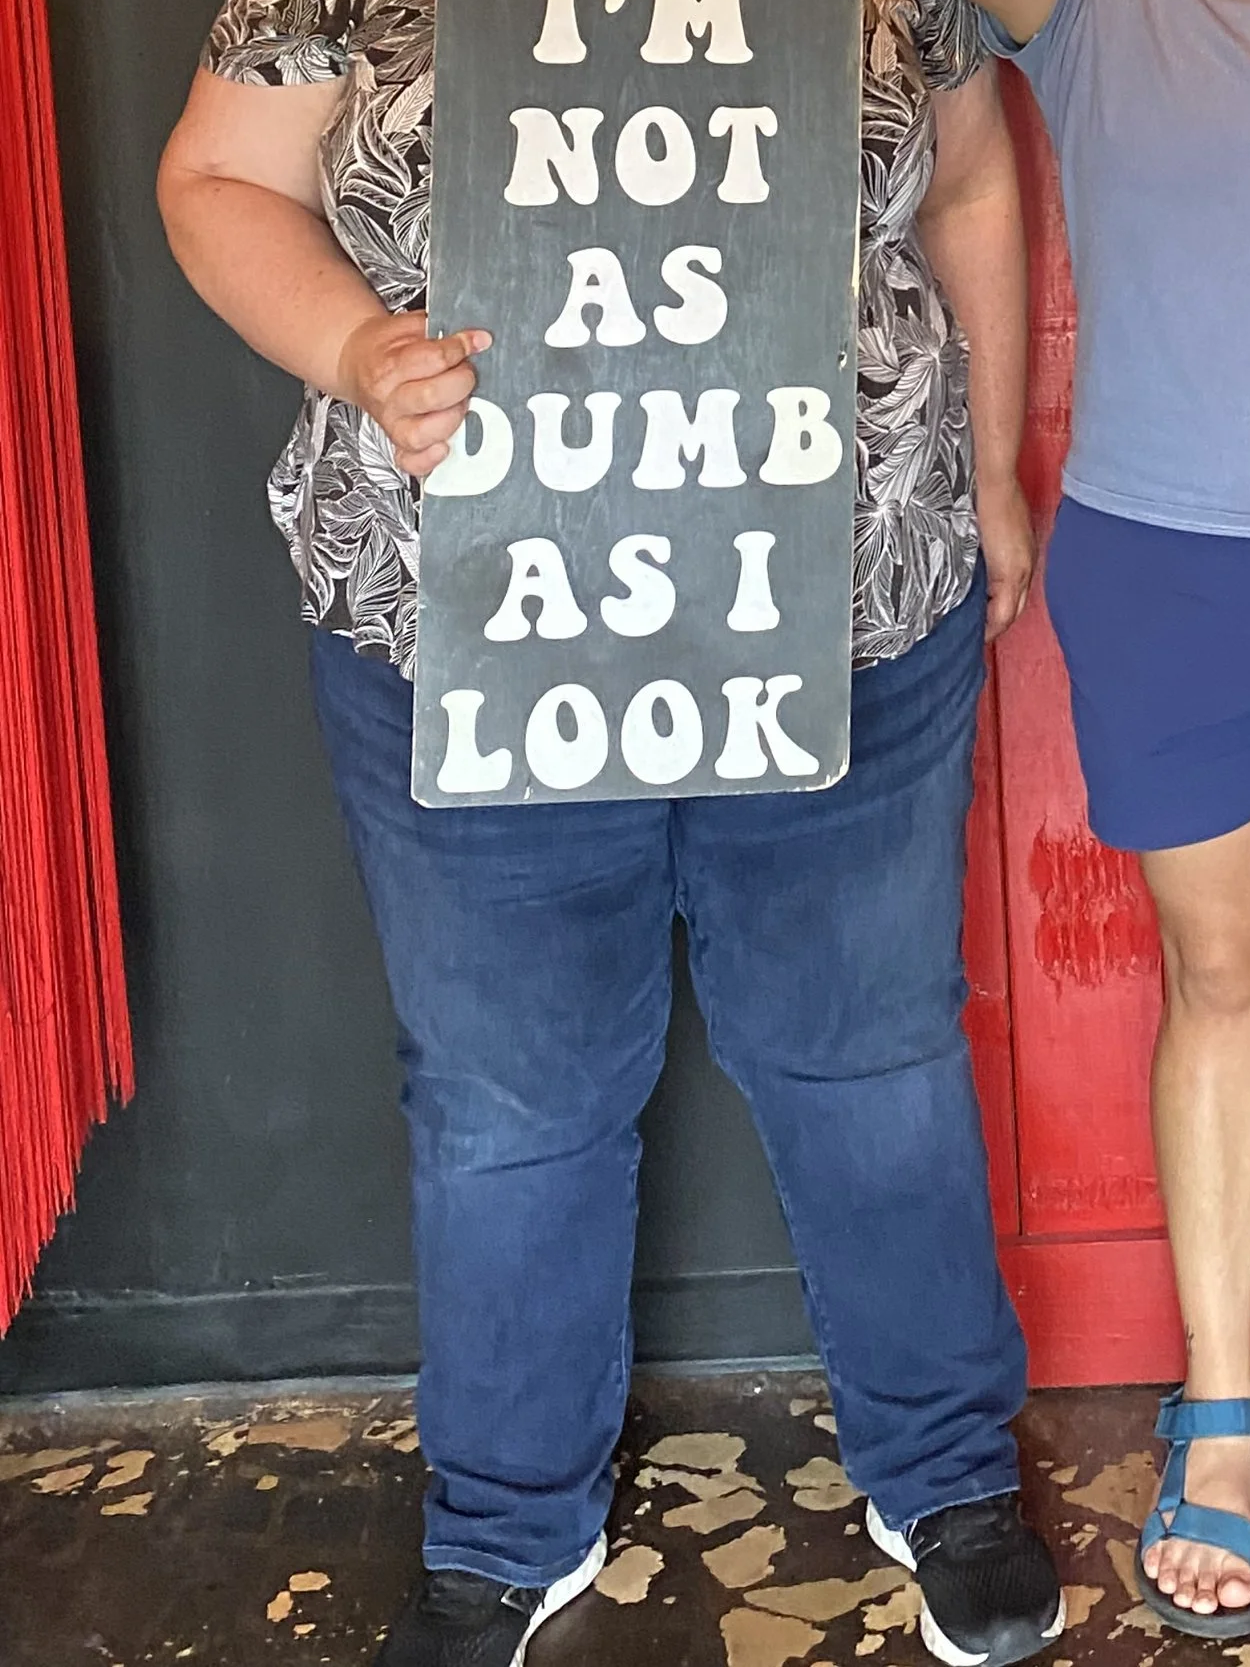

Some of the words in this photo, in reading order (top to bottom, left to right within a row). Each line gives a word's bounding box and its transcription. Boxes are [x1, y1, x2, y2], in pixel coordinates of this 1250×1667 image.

[503, 105, 778, 206] NOT
[543, 245, 729, 348] AS
[424, 387, 844, 497] DUMB
[483, 534, 677, 642] AS
[726, 531, 780, 632] I
[436, 674, 820, 794] LOOK
